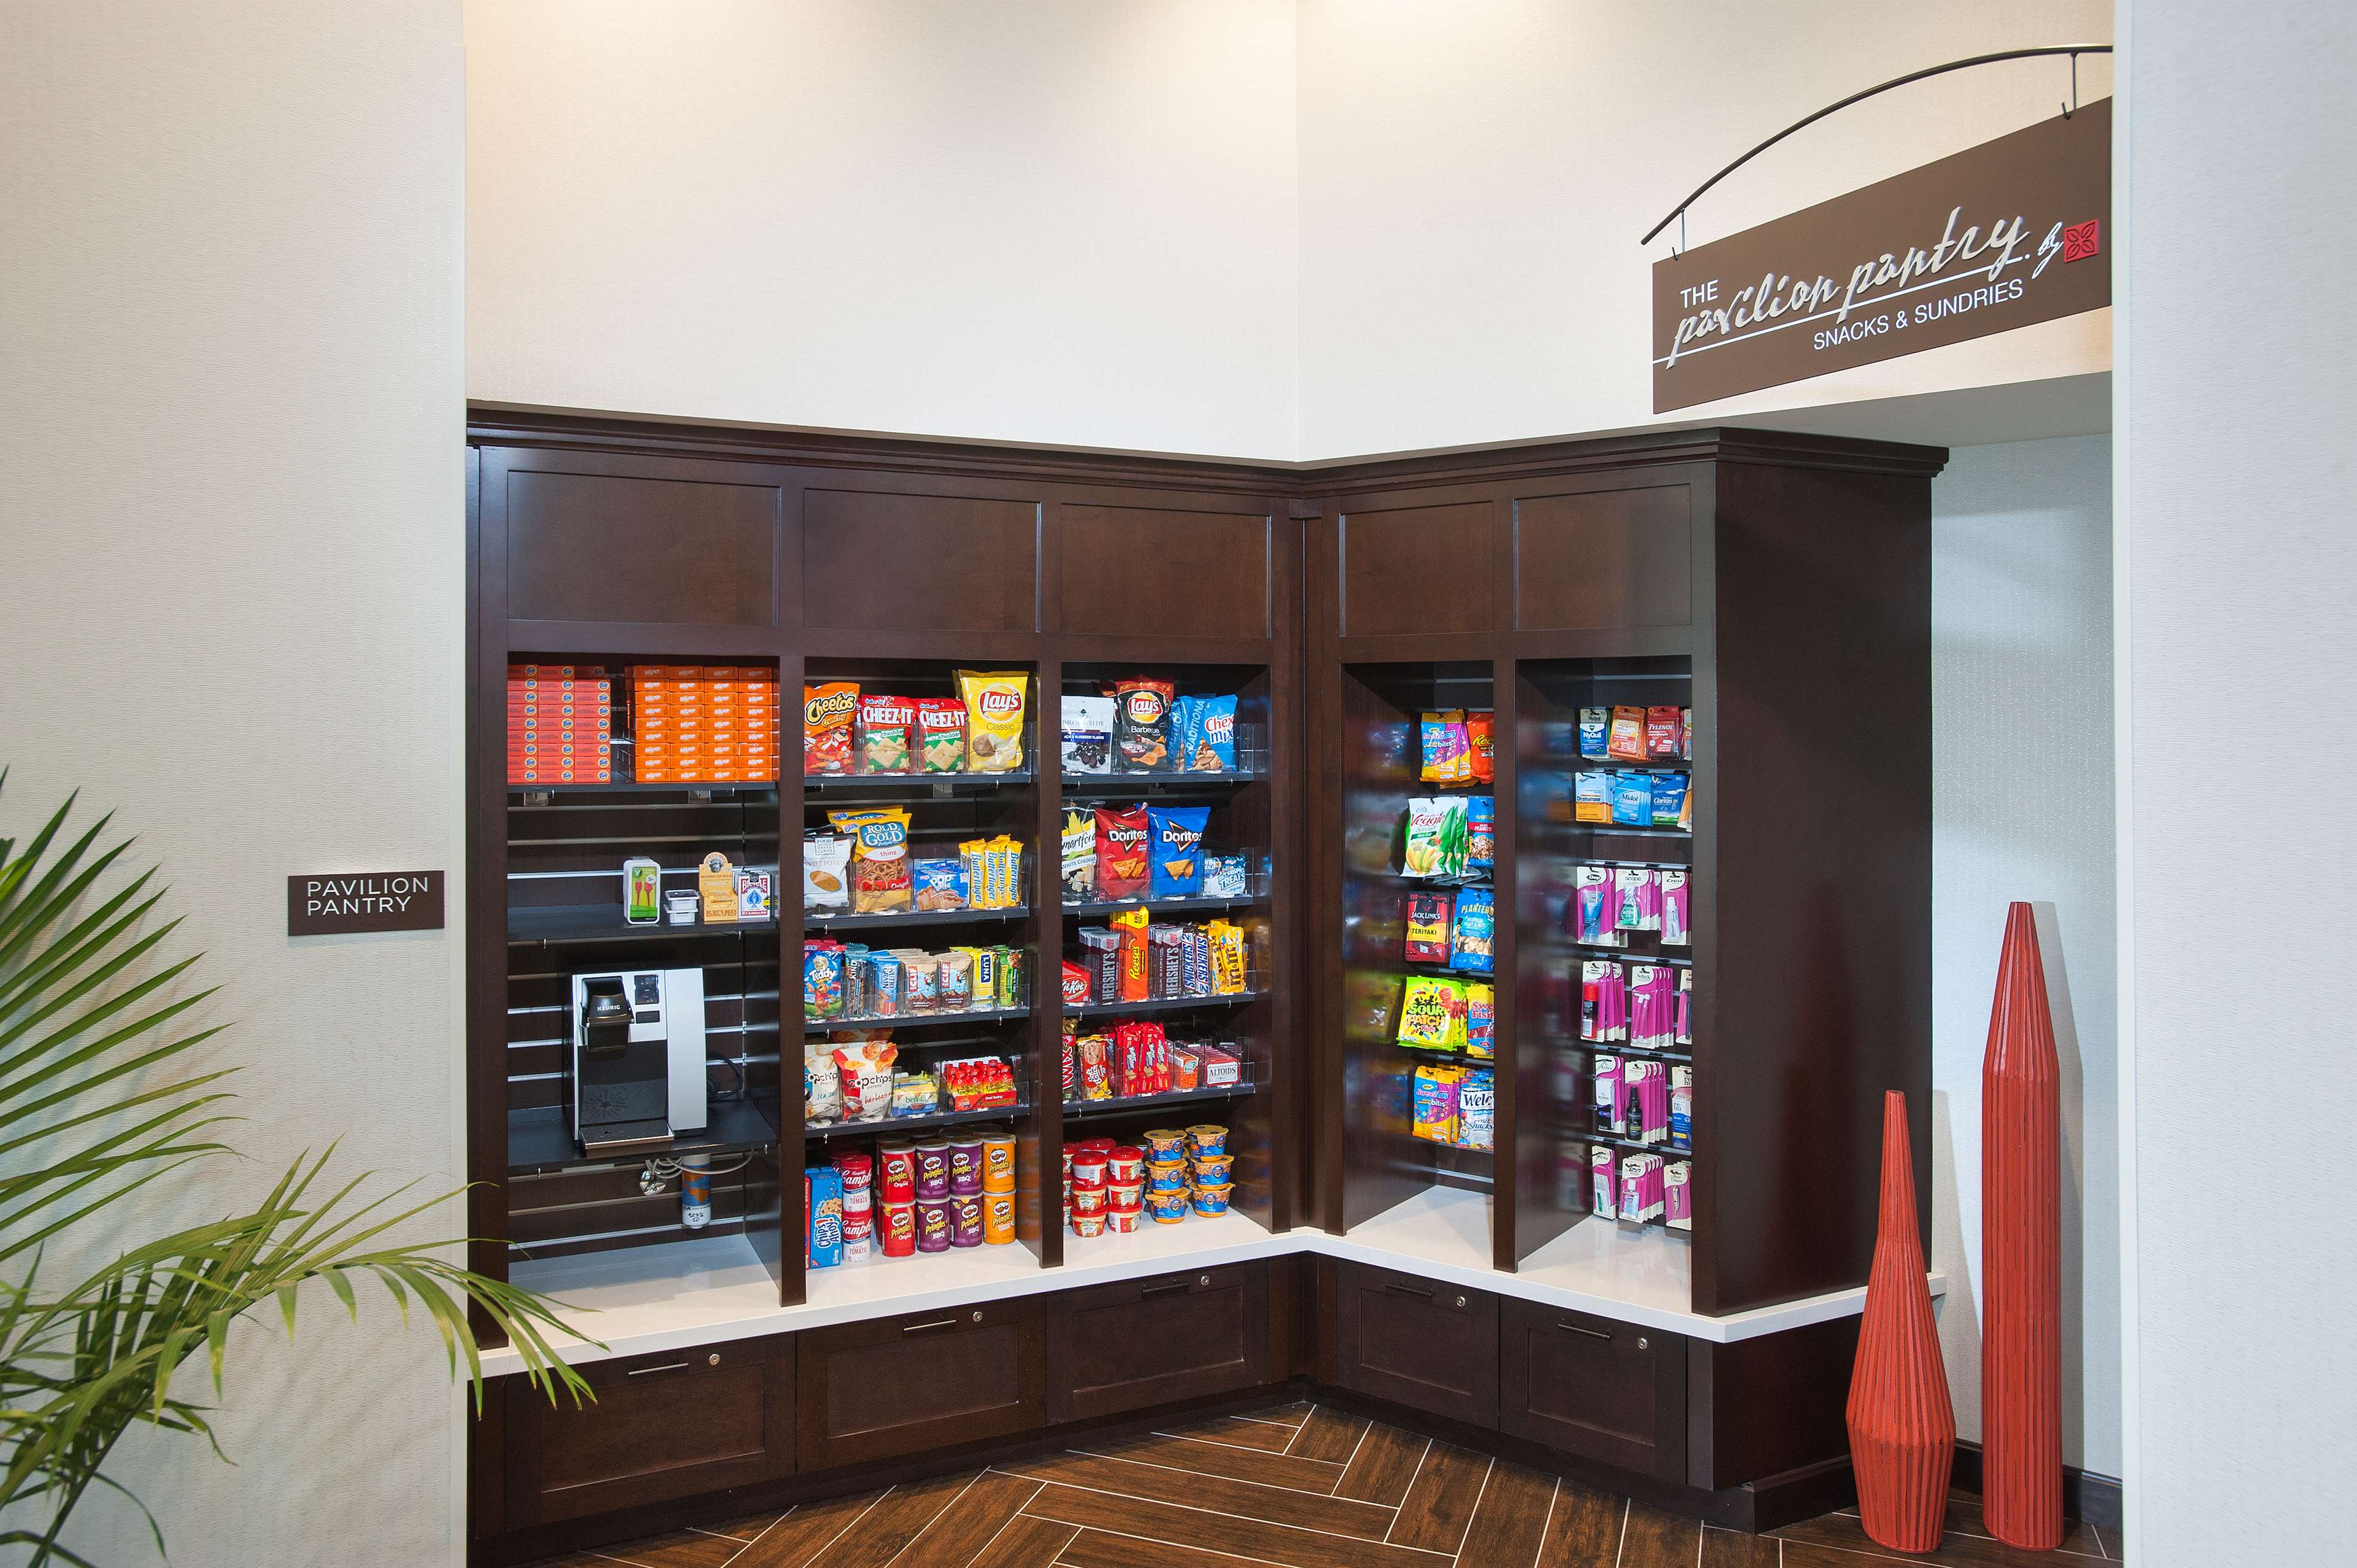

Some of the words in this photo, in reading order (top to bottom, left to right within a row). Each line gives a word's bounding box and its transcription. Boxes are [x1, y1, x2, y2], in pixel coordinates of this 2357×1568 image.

[2032, 221, 2065, 279] by
[1680, 280, 1719, 308] THE
[1666, 272, 1841, 369] pavilion
[1813, 310, 1889, 350] SNACKS
[1895, 311, 1909, 330] &
[1914, 279, 2024, 323] SUNDRIES
[805, 691, 856, 725] Cheetos
[982, 692, 1019, 713] Lay's
[1131, 698, 1159, 714] Lay's
[986, 722, 1015, 731] Classic
[1204, 714, 1234, 732] Chex
[1621, 793, 1638, 802] Midol
[867, 823, 897, 833] ROLD
[1109, 829, 1147, 842] Doritos
[865, 830, 903, 846] GOLD
[1163, 830, 1202, 843] Doritos
[971, 853, 982, 903] Butterfinger
[986, 852, 997, 902] Butterfinger
[1010, 852, 1020, 902] Butterfinger
[1219, 874, 1245, 890] TREATS
[307, 876, 428, 897] PAVILION
[307, 896, 411, 916] PANTRY
[1129, 946, 1140, 981] Reese's
[1182, 943, 1195, 989] SNICKERS
[1197, 937, 1209, 984] SNICKERS
[809, 965, 837, 982] Teddy
[1102, 952, 1115, 1000] HERSHEY'S
[1166, 947, 1179, 995] HERSHEY'S
[1409, 1003, 1444, 1016] SOUR
[1407, 1015, 1445, 1026] PATCH
[1062, 1046, 1074, 1089] TWIX
[1209, 1067, 1236, 1076] ALTOIDS
[848, 1075, 891, 1090] popchips
[923, 1167, 944, 1182] Pringles
[952, 1164, 972, 1177] Pringles
[988, 1161, 1009, 1175] Pringles
[887, 1172, 908, 1185] Pringles
[961, 1215, 981, 1230] Pringles
[993, 1211, 1012, 1227] Pringles
[818, 1223, 831, 1248] Chips
[891, 1224, 911, 1238] Pringles
[925, 1220, 946, 1236] Pringles
